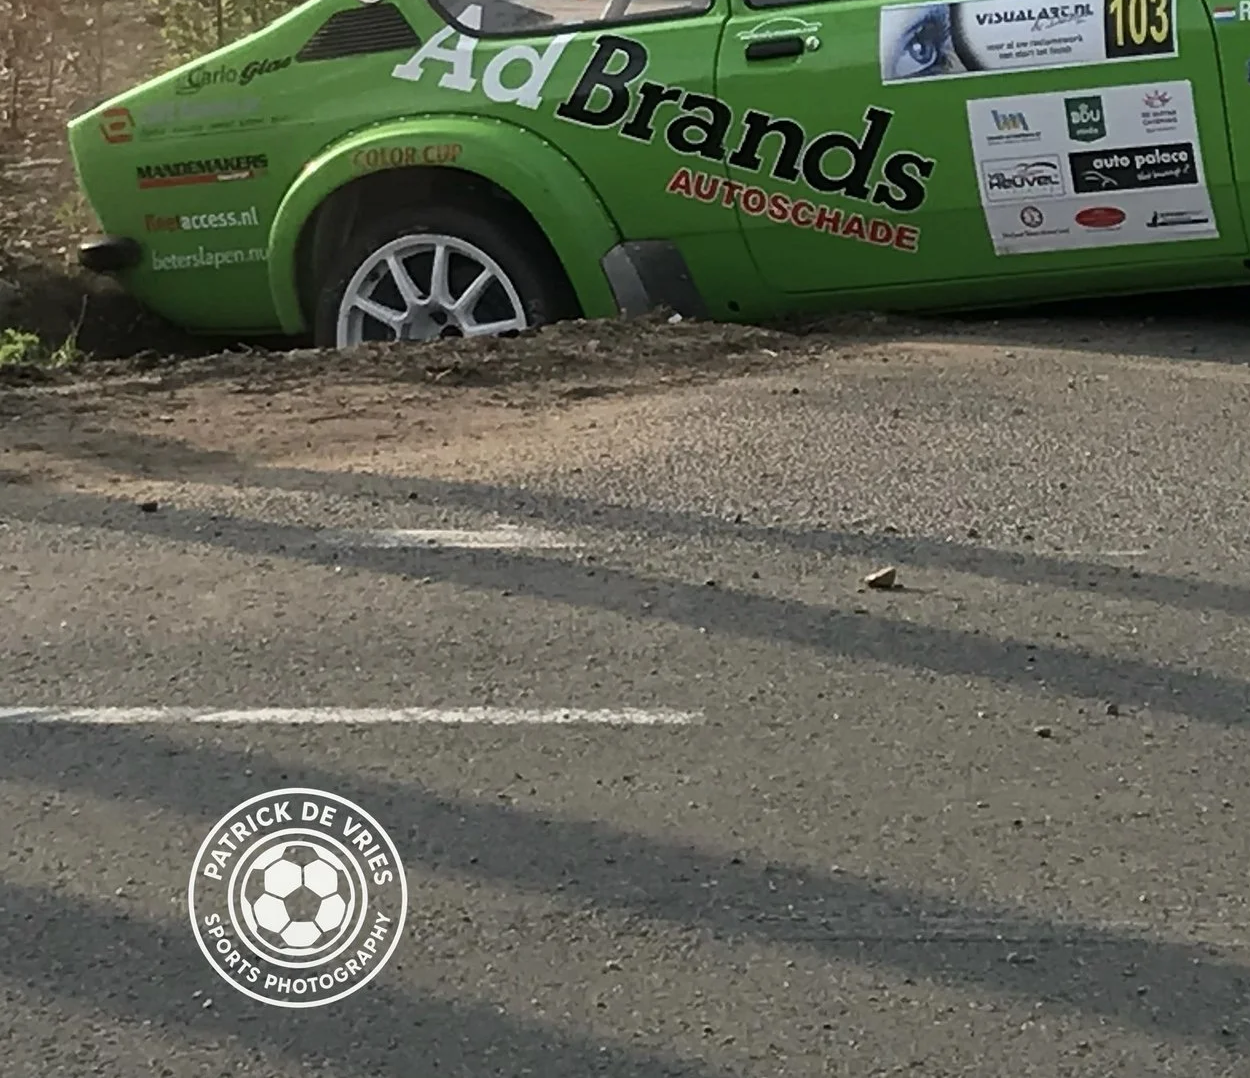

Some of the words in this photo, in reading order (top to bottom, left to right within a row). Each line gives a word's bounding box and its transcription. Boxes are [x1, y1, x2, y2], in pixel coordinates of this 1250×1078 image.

[555, 34, 936, 213] Brands
[353, 145, 417, 167] COLOR
[423, 142, 464, 163] CUP
[1093, 153, 1130, 168] auto
[1135, 149, 1188, 170] palace
[665, 167, 920, 253] AUTOSCHADE
